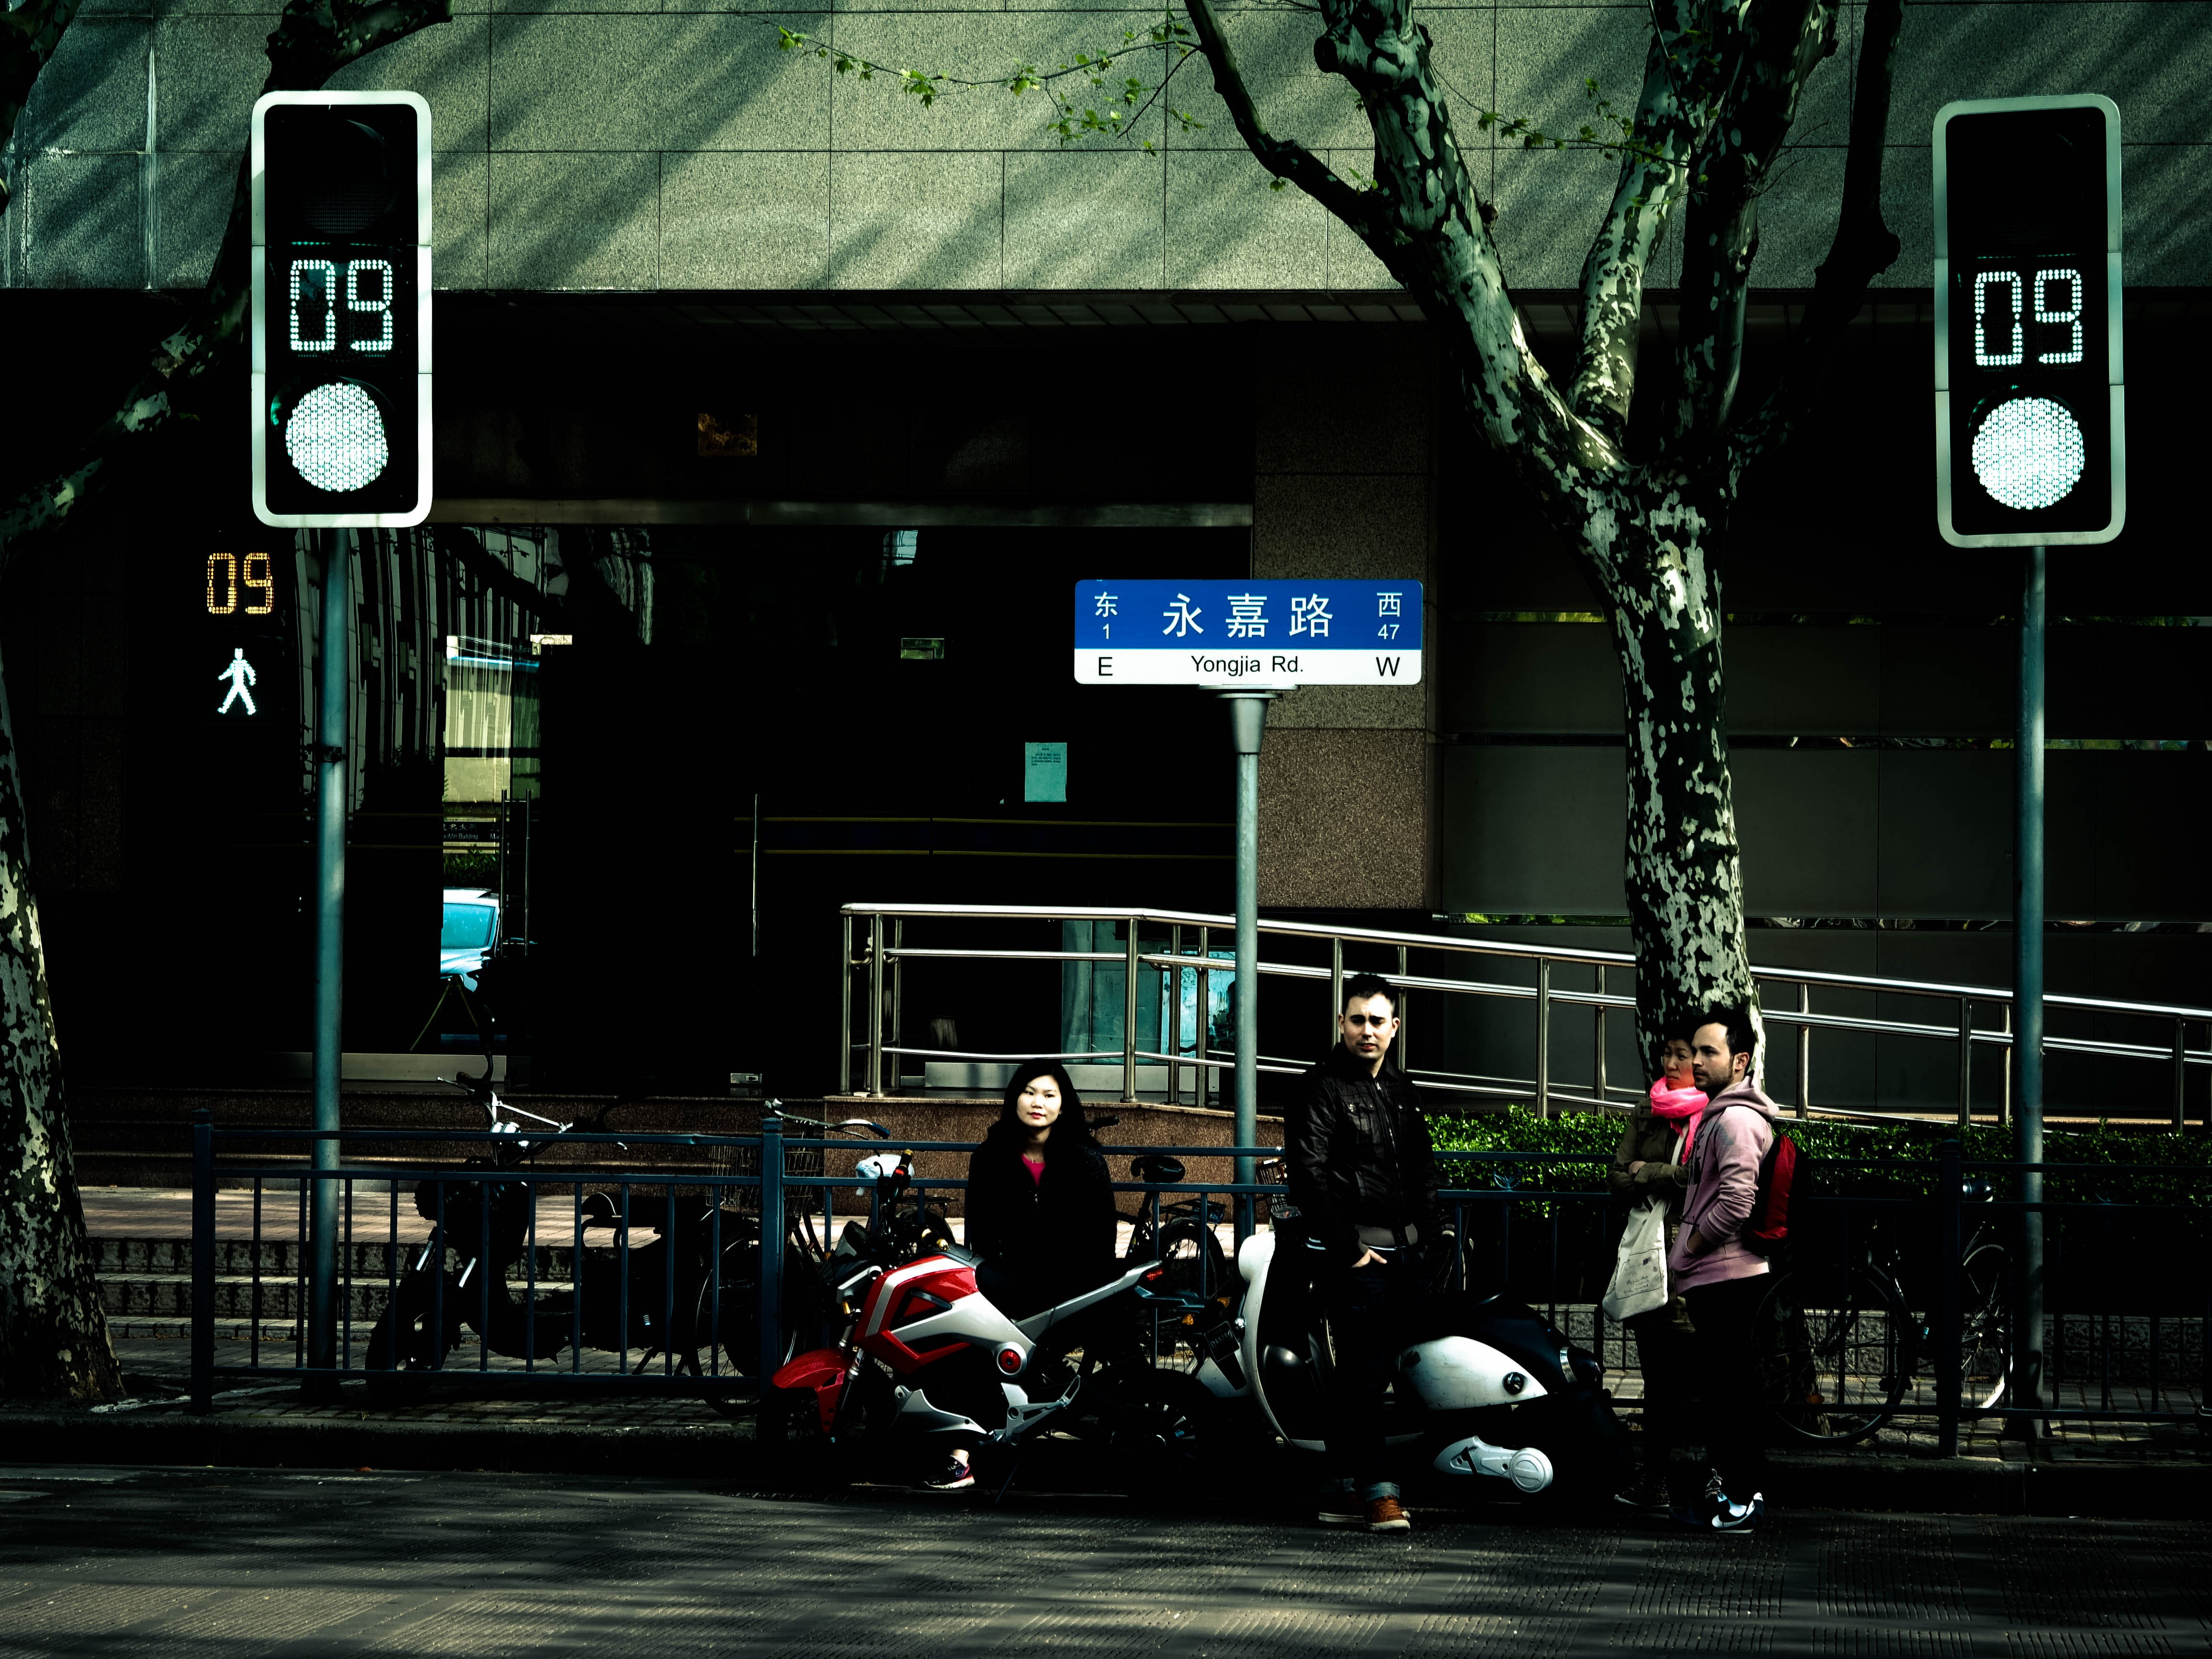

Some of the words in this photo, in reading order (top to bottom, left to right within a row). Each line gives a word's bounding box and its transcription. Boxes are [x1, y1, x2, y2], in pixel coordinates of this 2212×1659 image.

[290, 259, 393, 352] 09
[1974, 268, 2083, 367] 09
[207, 552, 274, 615] 09
[1094, 591, 1118, 618] 东
[1162, 593, 1333, 638] 永嘉路
[1376, 591, 1403, 617] 西
[1103, 624, 1109, 640] 1
[1377, 624, 1401, 640] 47
[1098, 657, 1113, 676] E
[1191, 655, 1261, 677] Yongjia
[1272, 656, 1303, 673] Rd.
[1376, 657, 1401, 676] W
